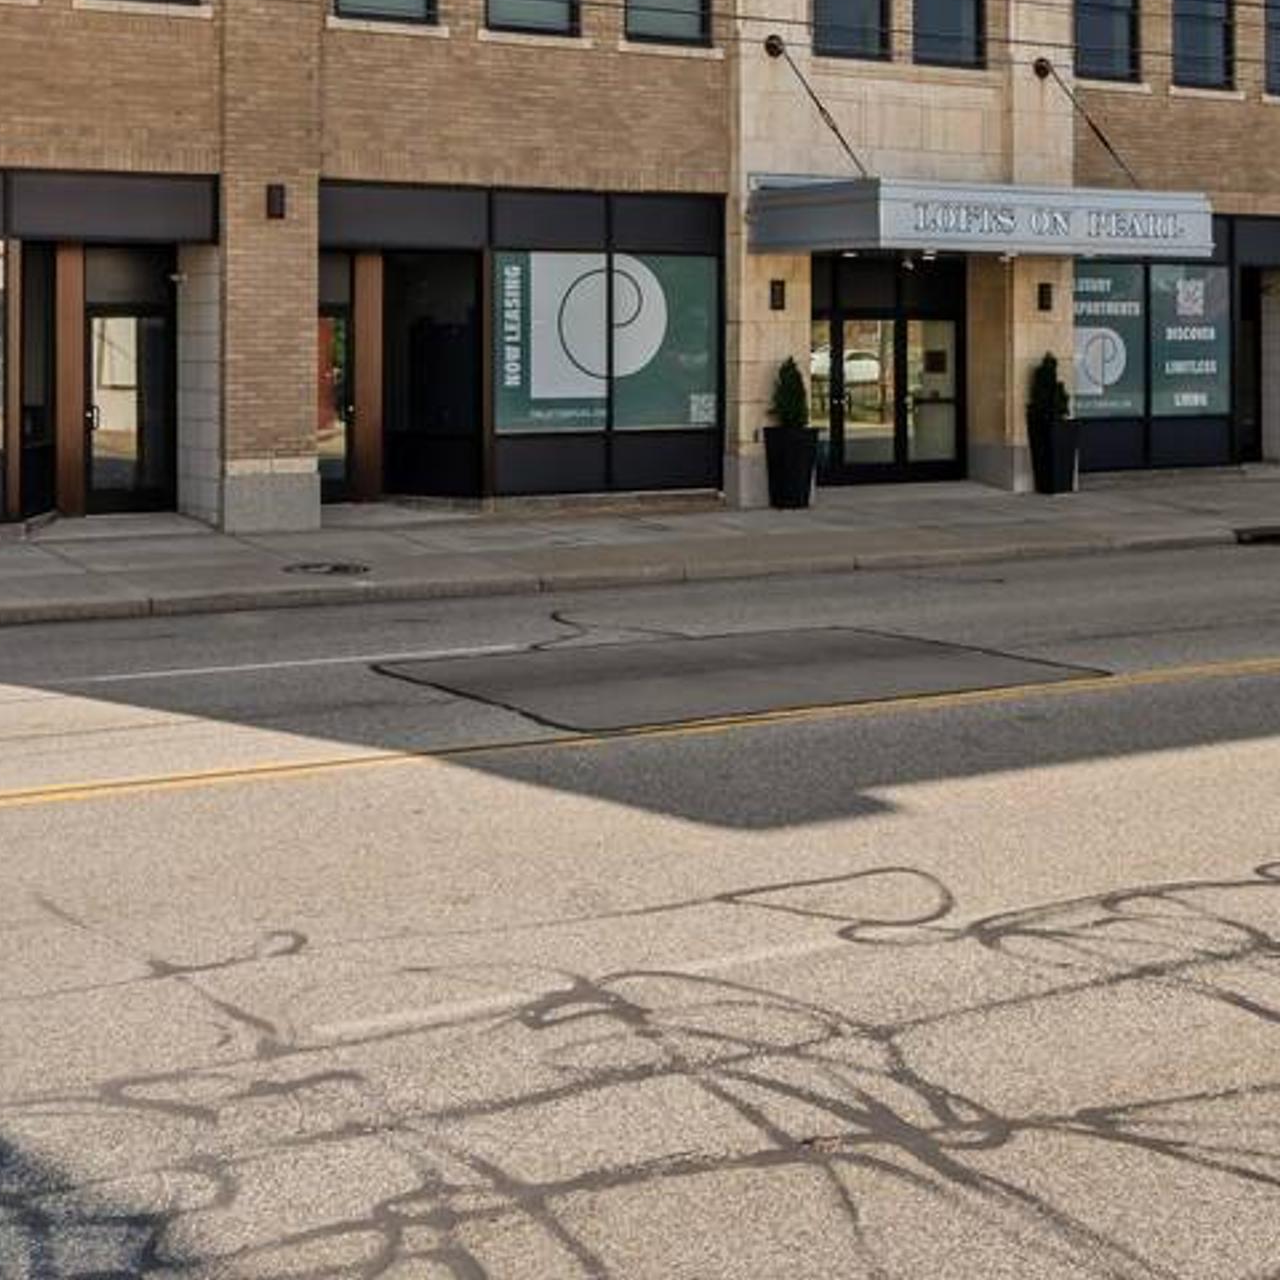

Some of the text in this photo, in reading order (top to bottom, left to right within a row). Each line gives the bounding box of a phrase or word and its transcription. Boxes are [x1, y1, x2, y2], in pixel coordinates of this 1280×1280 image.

[914, 203, 1185, 238] LOFTS ON PEARL
[504, 265, 521, 385] NOW LEASING
[1166, 326, 1216, 341] DISCOVER
